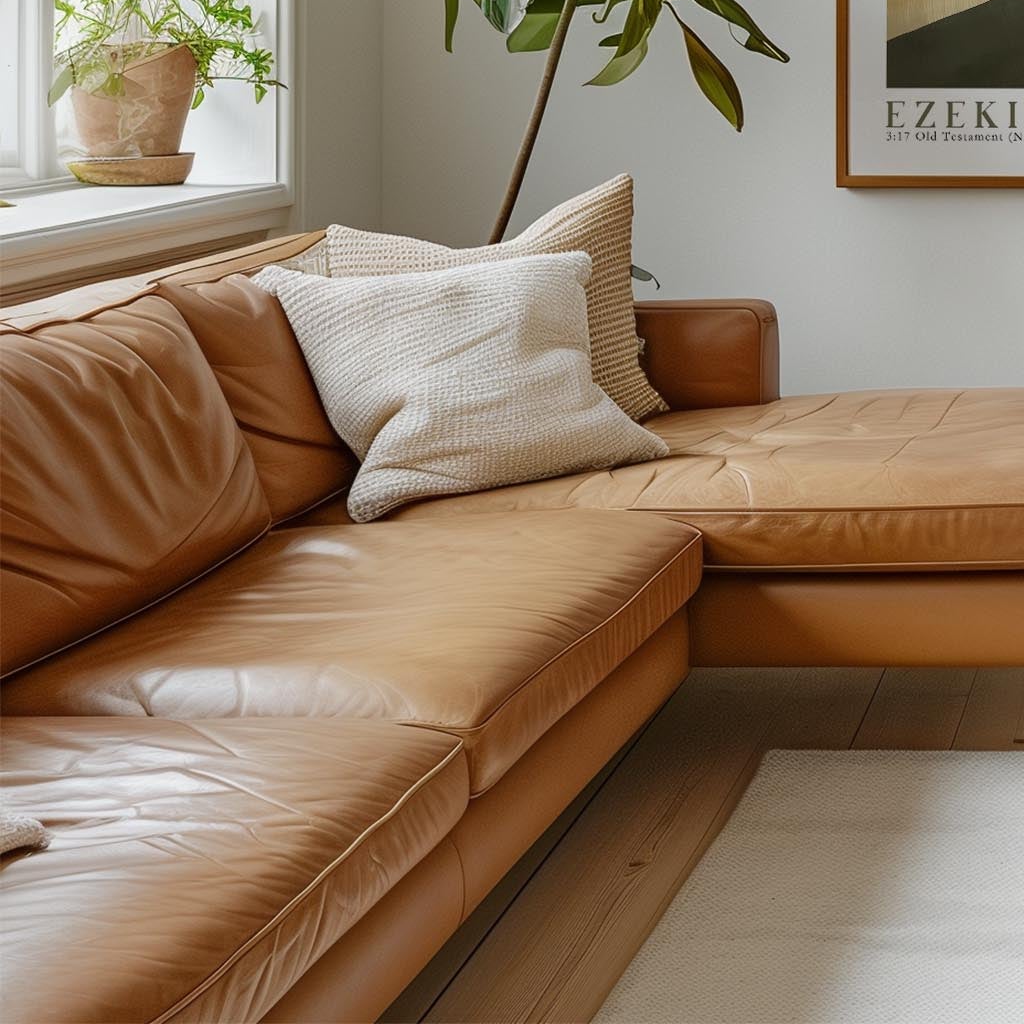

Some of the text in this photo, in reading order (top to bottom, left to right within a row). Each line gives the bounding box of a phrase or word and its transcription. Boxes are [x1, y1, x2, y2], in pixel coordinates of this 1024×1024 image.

[886, 131, 910, 142] 3:17
[915, 131, 937, 142] Old
[941, 131, 1004, 142] Testament
